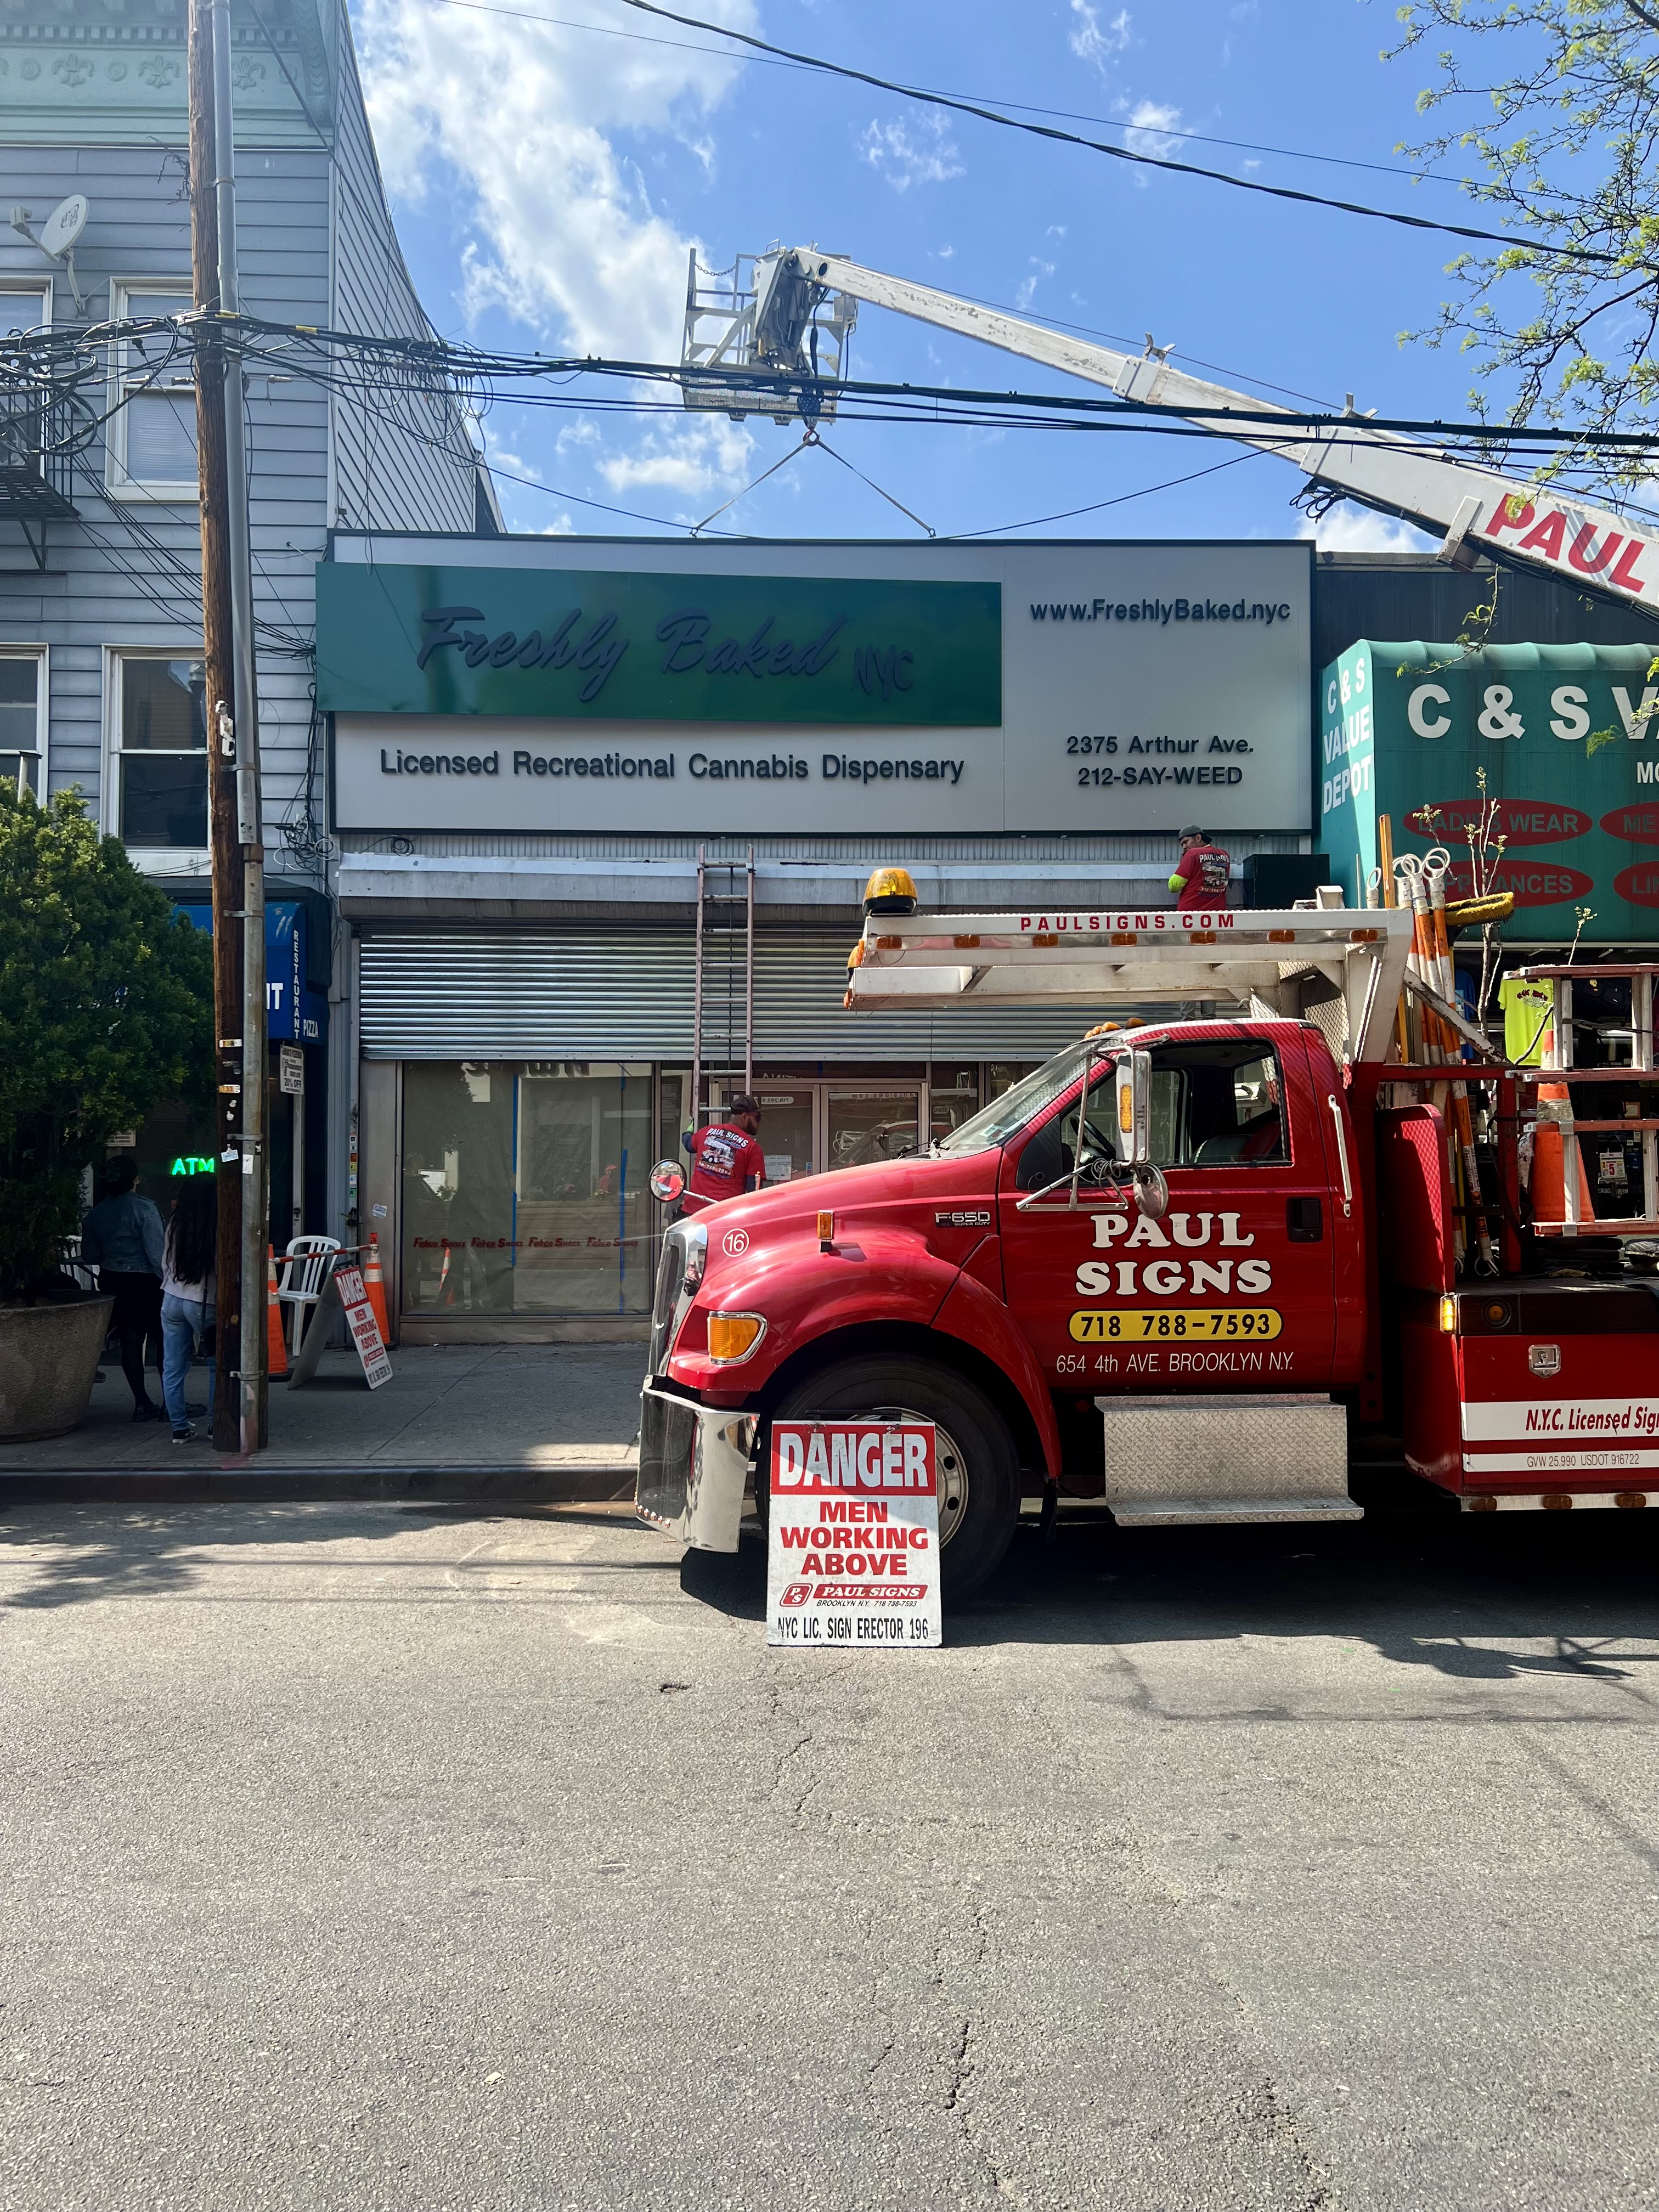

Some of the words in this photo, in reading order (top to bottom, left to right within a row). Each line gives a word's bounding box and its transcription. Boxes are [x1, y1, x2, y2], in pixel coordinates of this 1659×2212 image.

[1485, 493, 1646, 592] PAUL
[1030, 599, 1291, 625] www.FreshlyBaked.nyc
[416, 606, 630, 703] Freshly
[656, 607, 848, 678] Baked
[851, 644, 913, 701] NYC
[1328, 680, 1336, 714] C
[1341, 669, 1351, 704] &
[1356, 658, 1365, 693] S
[1408, 684, 1452, 739] C
[1477, 685, 1526, 739] &
[1549, 686, 1590, 740] S
[1611, 687, 1659, 740] V
[1066, 736, 1118, 754] 2375
[1128, 735, 1199, 754] Arthur
[1208, 735, 1254, 753] Ave.
[1324, 704, 1370, 765] VALUE
[380, 748, 498, 774] Licensed
[513, 751, 675, 777] Recreational
[689, 753, 809, 779] Cannabis
[822, 754, 964, 784] Dispensary
[1078, 766, 1243, 785] 212-SAY-WEED
[1637, 762, 1659, 783] M
[1323, 754, 1372, 814] DEPOT
[1510, 814, 1578, 833] WEAR
[1199, 854, 1215, 864] PAUL
[1426, 874, 1573, 894] PPANCES
[1020, 914, 1233, 930] PAULSIGNS.COM
[303, 1019, 319, 1038] PIZZA
[706, 1128, 724, 1137] PAUL
[725, 1132, 749, 1148] SIGNS
[172, 1157, 215, 1176] ATM
[1090, 1212, 1255, 1248] PAUL
[727, 1233, 745, 1252] 16
[1075, 1260, 1272, 1295] SIGNS
[336, 1271, 368, 1306] DANGER
[354, 1308, 367, 1322] MEN
[1081, 1316, 1121, 1336] 718
[1142, 1314, 1271, 1336] 788-7593
[353, 1318, 377, 1338] WORKING
[361, 1333, 379, 1350] ABOVE
[1057, 1355, 1086, 1373] 654
[1094, 1354, 1118, 1372] 4th
[1126, 1353, 1161, 1372] AVE.
[1169, 1352, 1262, 1372] BROOKLYN
[1269, 1352, 1294, 1370] N.Y.
[1526, 1408, 1564, 1431] N.Y.C.
[1568, 1406, 1631, 1430] Licensed
[1634, 1406, 1659, 1434] Sig
[779, 1432, 928, 1487] DANGER
[1527, 1455, 1547, 1468] GVW
[1548, 1455, 1576, 1468] 25,990
[1581, 1454, 1609, 1466] USDOT
[1611, 1453, 1640, 1465] 916722
[820, 1502, 888, 1522] MEN
[780, 1527, 928, 1549] WORKING
[801, 1554, 907, 1575] ABOVE
[822, 1587, 866, 1596] PAUL
[869, 1587, 921, 1596] SIGNS
[778, 1617, 798, 1638] NYC
[804, 1617, 822, 1639] LIC.
[827, 1617, 851, 1639] SIGN
[857, 1618, 904, 1639] ERECTOR
[910, 1618, 928, 1640] 196
